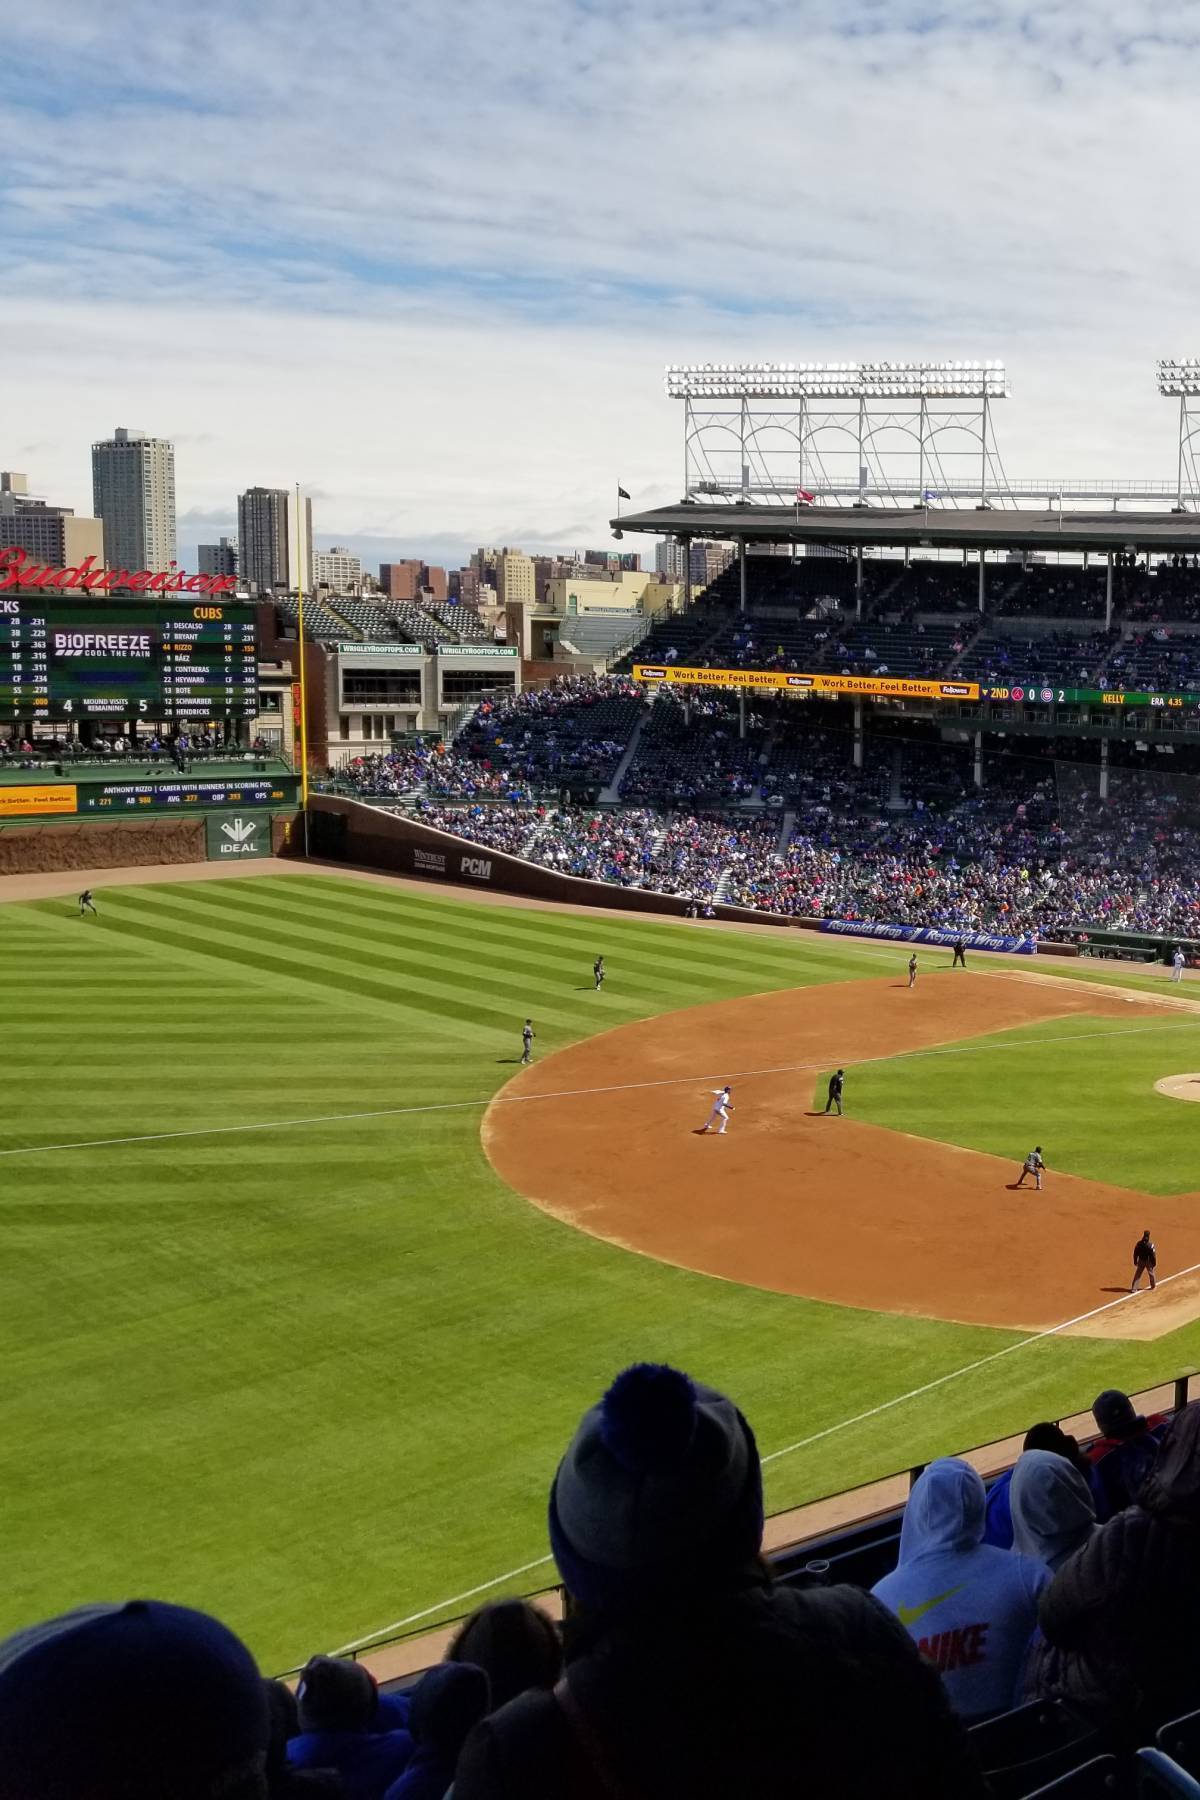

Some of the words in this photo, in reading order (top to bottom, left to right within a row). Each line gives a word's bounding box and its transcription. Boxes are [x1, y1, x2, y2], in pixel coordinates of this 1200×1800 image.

[0, 546, 238, 594] Budweiser
[193, 606, 222, 619] CUBS
[343, 644, 420, 654] WRIGLEYROOFTOPS.COM
[442, 647, 514, 656] WRIGLEYROOFTOPS.COM
[673, 670, 695, 680] Work
[698, 672, 726, 681] Better.
[728, 674, 746, 682] Feel
[749, 674, 778, 684] Better.
[822, 679, 844, 688] Work
[847, 680, 878, 690] Better.
[880, 682, 899, 691] Feel
[902, 684, 933, 693] Better.
[942, 686, 968, 694] Fellowes
[63, 700, 72, 712] 4
[139, 700, 148, 712] 5
[990, 688, 1008, 698] 2ND
[1028, 689, 1035, 700] 0
[1058, 690, 1064, 702] 2
[1103, 694, 1125, 704] KELLY
[1152, 698, 1164, 706] ERA
[1168, 698, 1182, 706] 4.35
[220, 843, 258, 852] IDEAL
[461, 857, 492, 876] PCM
[828, 920, 874, 935] Reynolds
[874, 924, 902, 939] Wrap
[926, 930, 974, 945] Reynolds
[974, 934, 1004, 949] Wrap
[917, 1622, 989, 1671] NIKE
